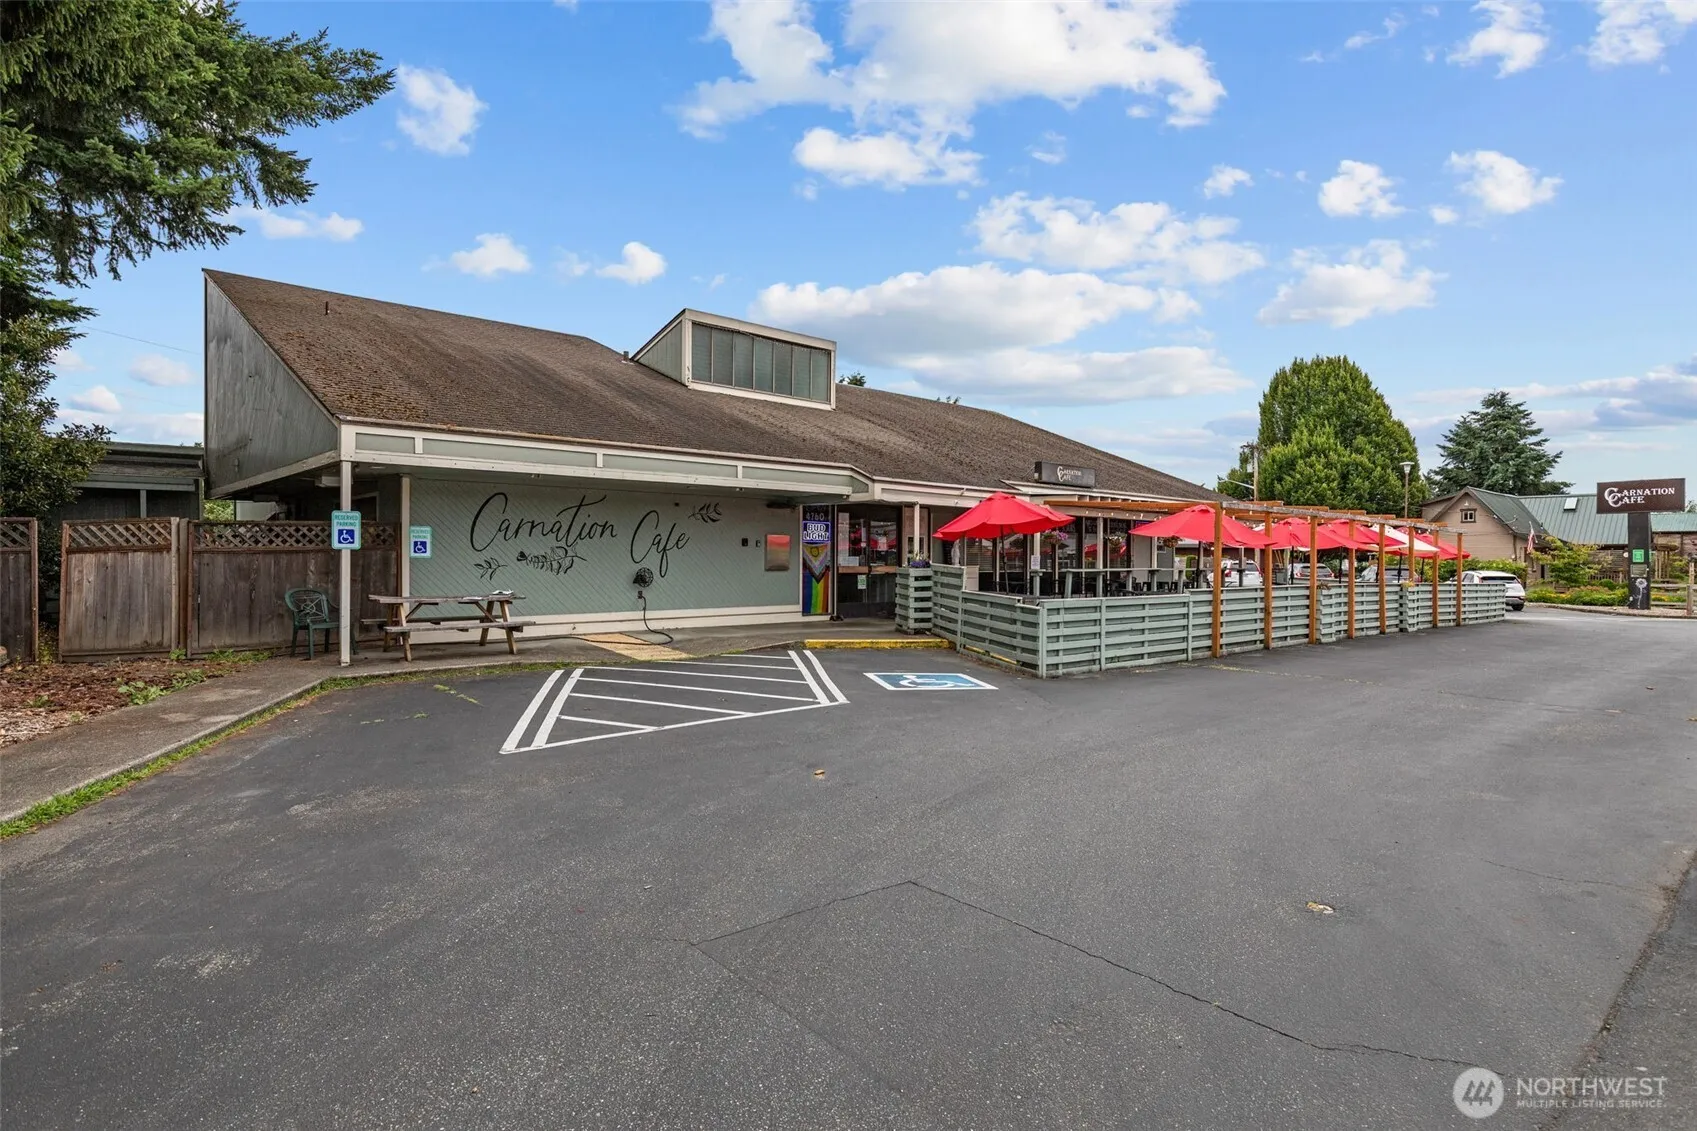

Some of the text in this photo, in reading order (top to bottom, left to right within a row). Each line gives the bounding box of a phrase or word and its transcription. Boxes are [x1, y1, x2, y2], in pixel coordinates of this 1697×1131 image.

[1604, 487, 1675, 500] CARNATION
[1608, 493, 1645, 507] CAFE
[807, 523, 826, 532] BUD
[470, 492, 691, 578] Carnation Cafe
[803, 531, 829, 540] LIGHT
